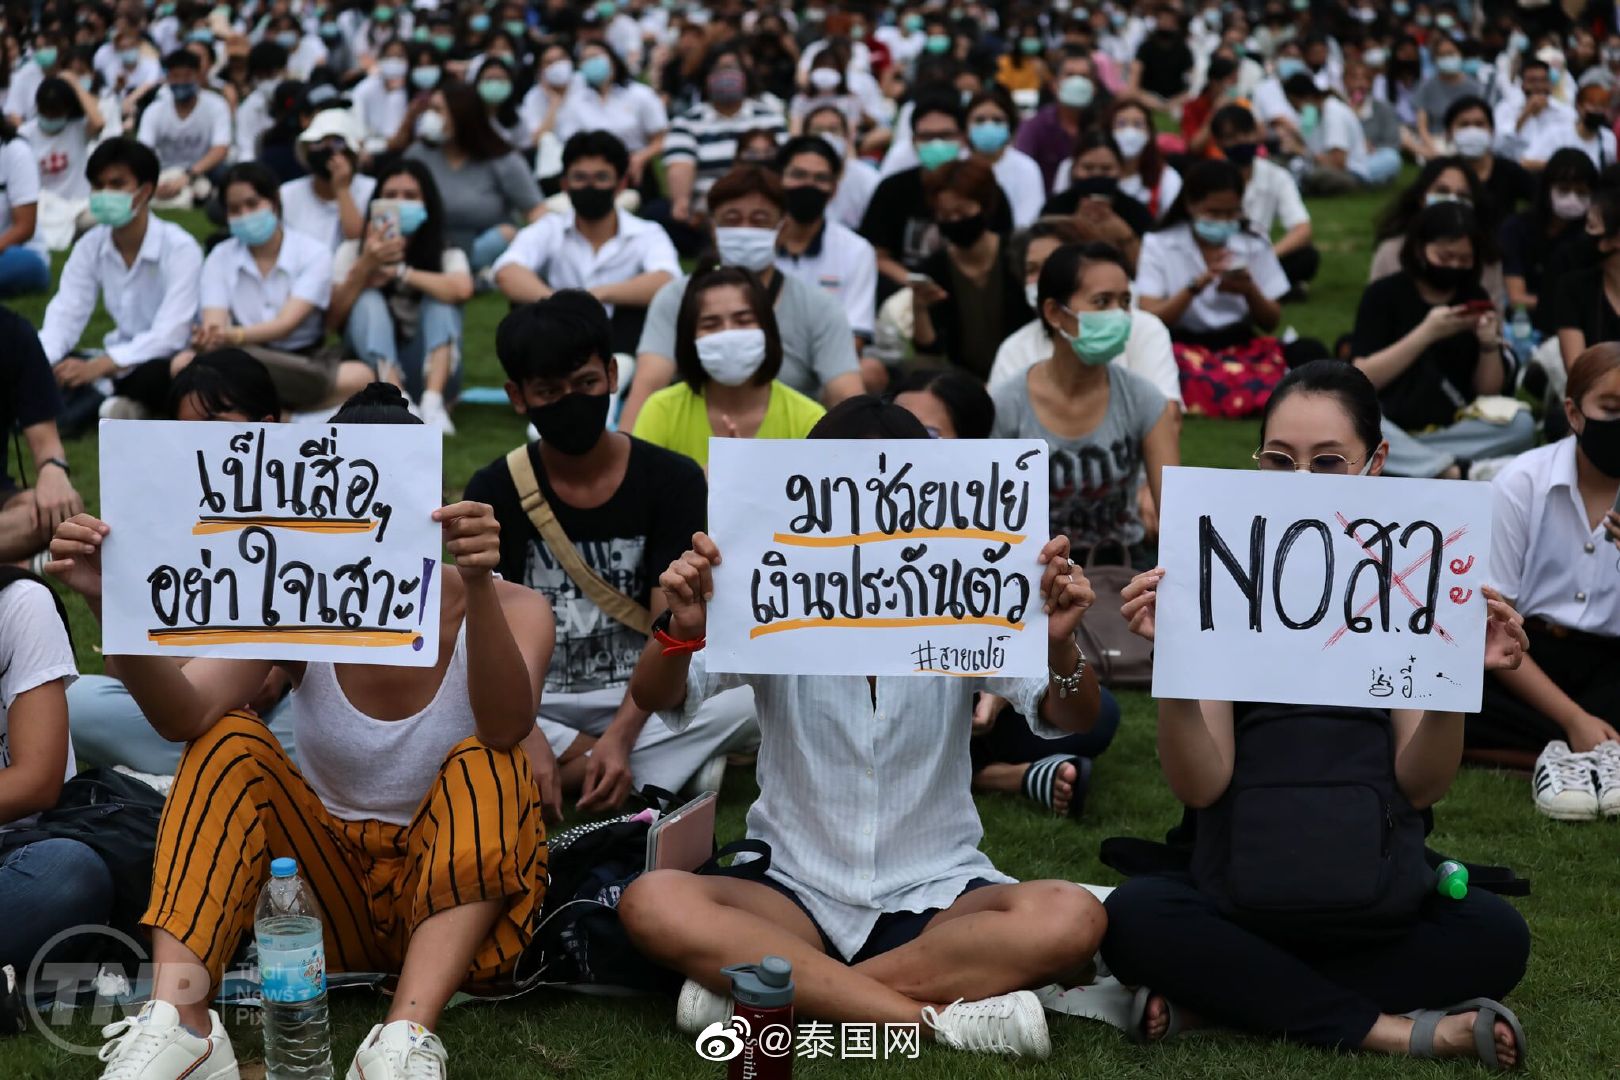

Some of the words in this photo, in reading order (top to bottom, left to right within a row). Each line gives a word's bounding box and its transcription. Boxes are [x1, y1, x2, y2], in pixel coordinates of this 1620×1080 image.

[785, 449, 1041, 535] มาช่วยเปย์
[751, 541, 1031, 624] เงินประกันตัว
